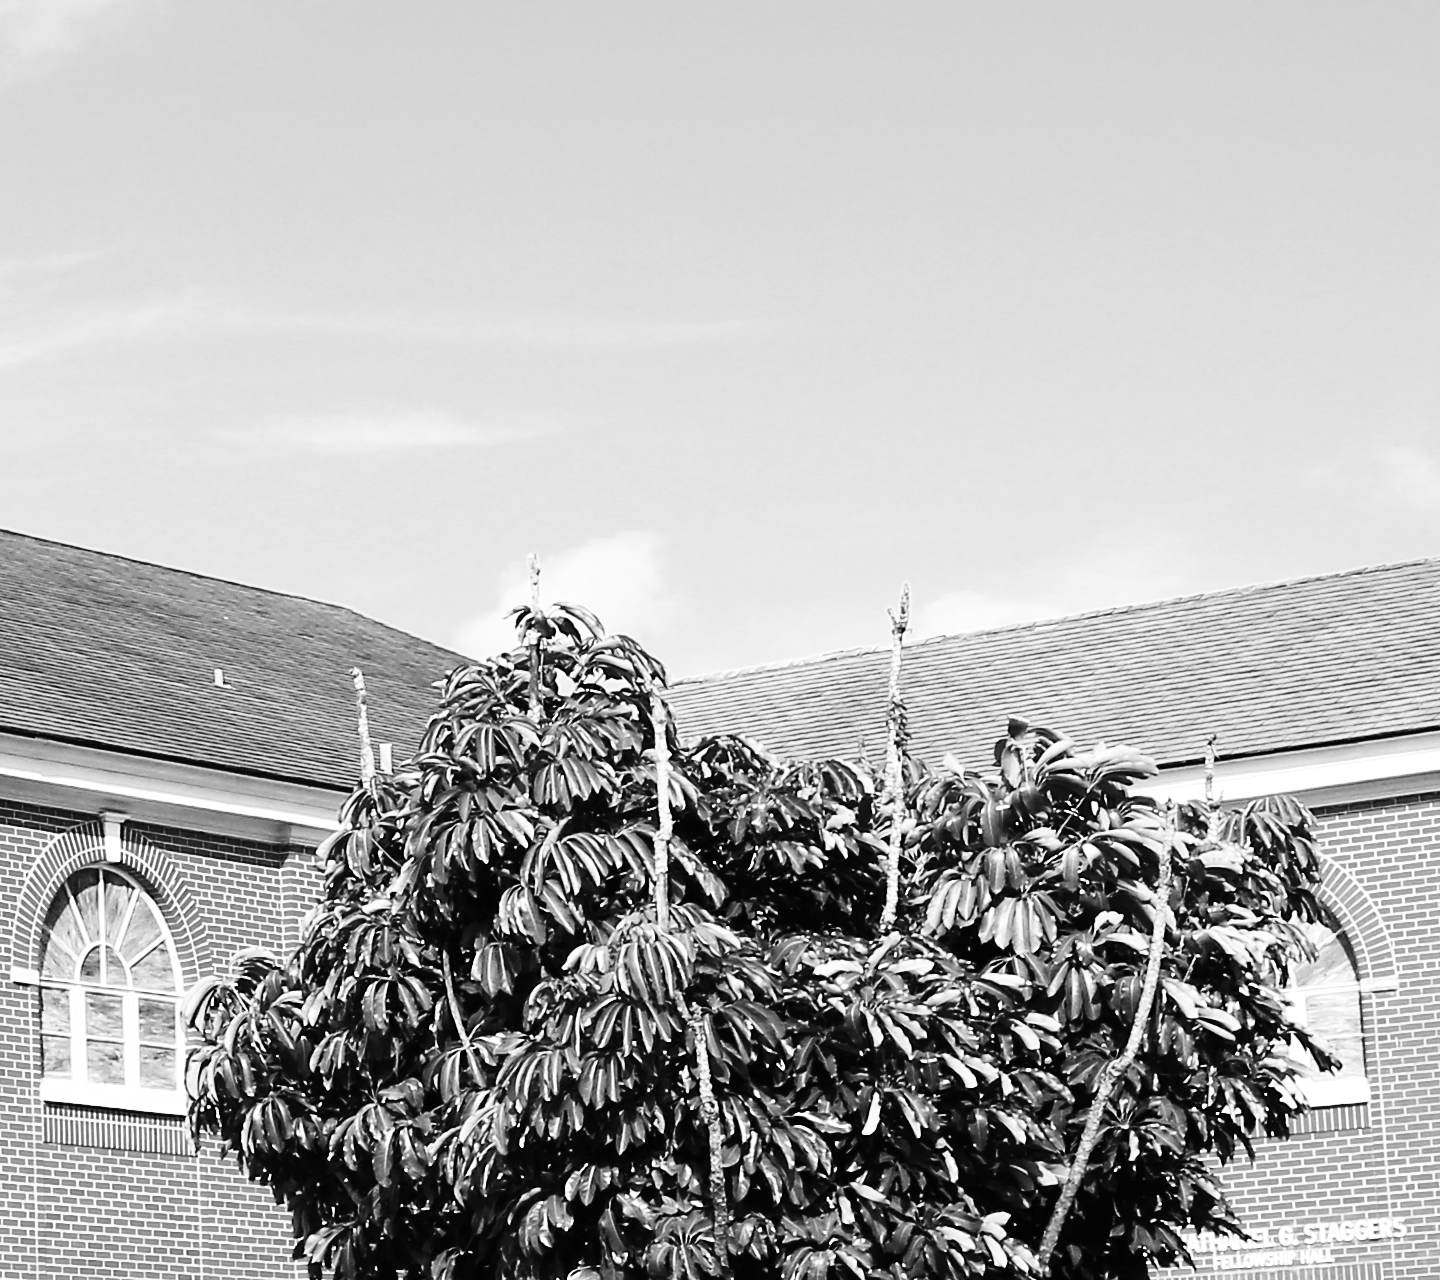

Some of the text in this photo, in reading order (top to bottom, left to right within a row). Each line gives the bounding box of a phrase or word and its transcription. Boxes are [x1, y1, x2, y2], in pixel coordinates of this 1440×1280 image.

[1303, 1218, 1408, 1245] STAGGERS
[1213, 1249, 1335, 1270] FELLOWSHIP HALL
